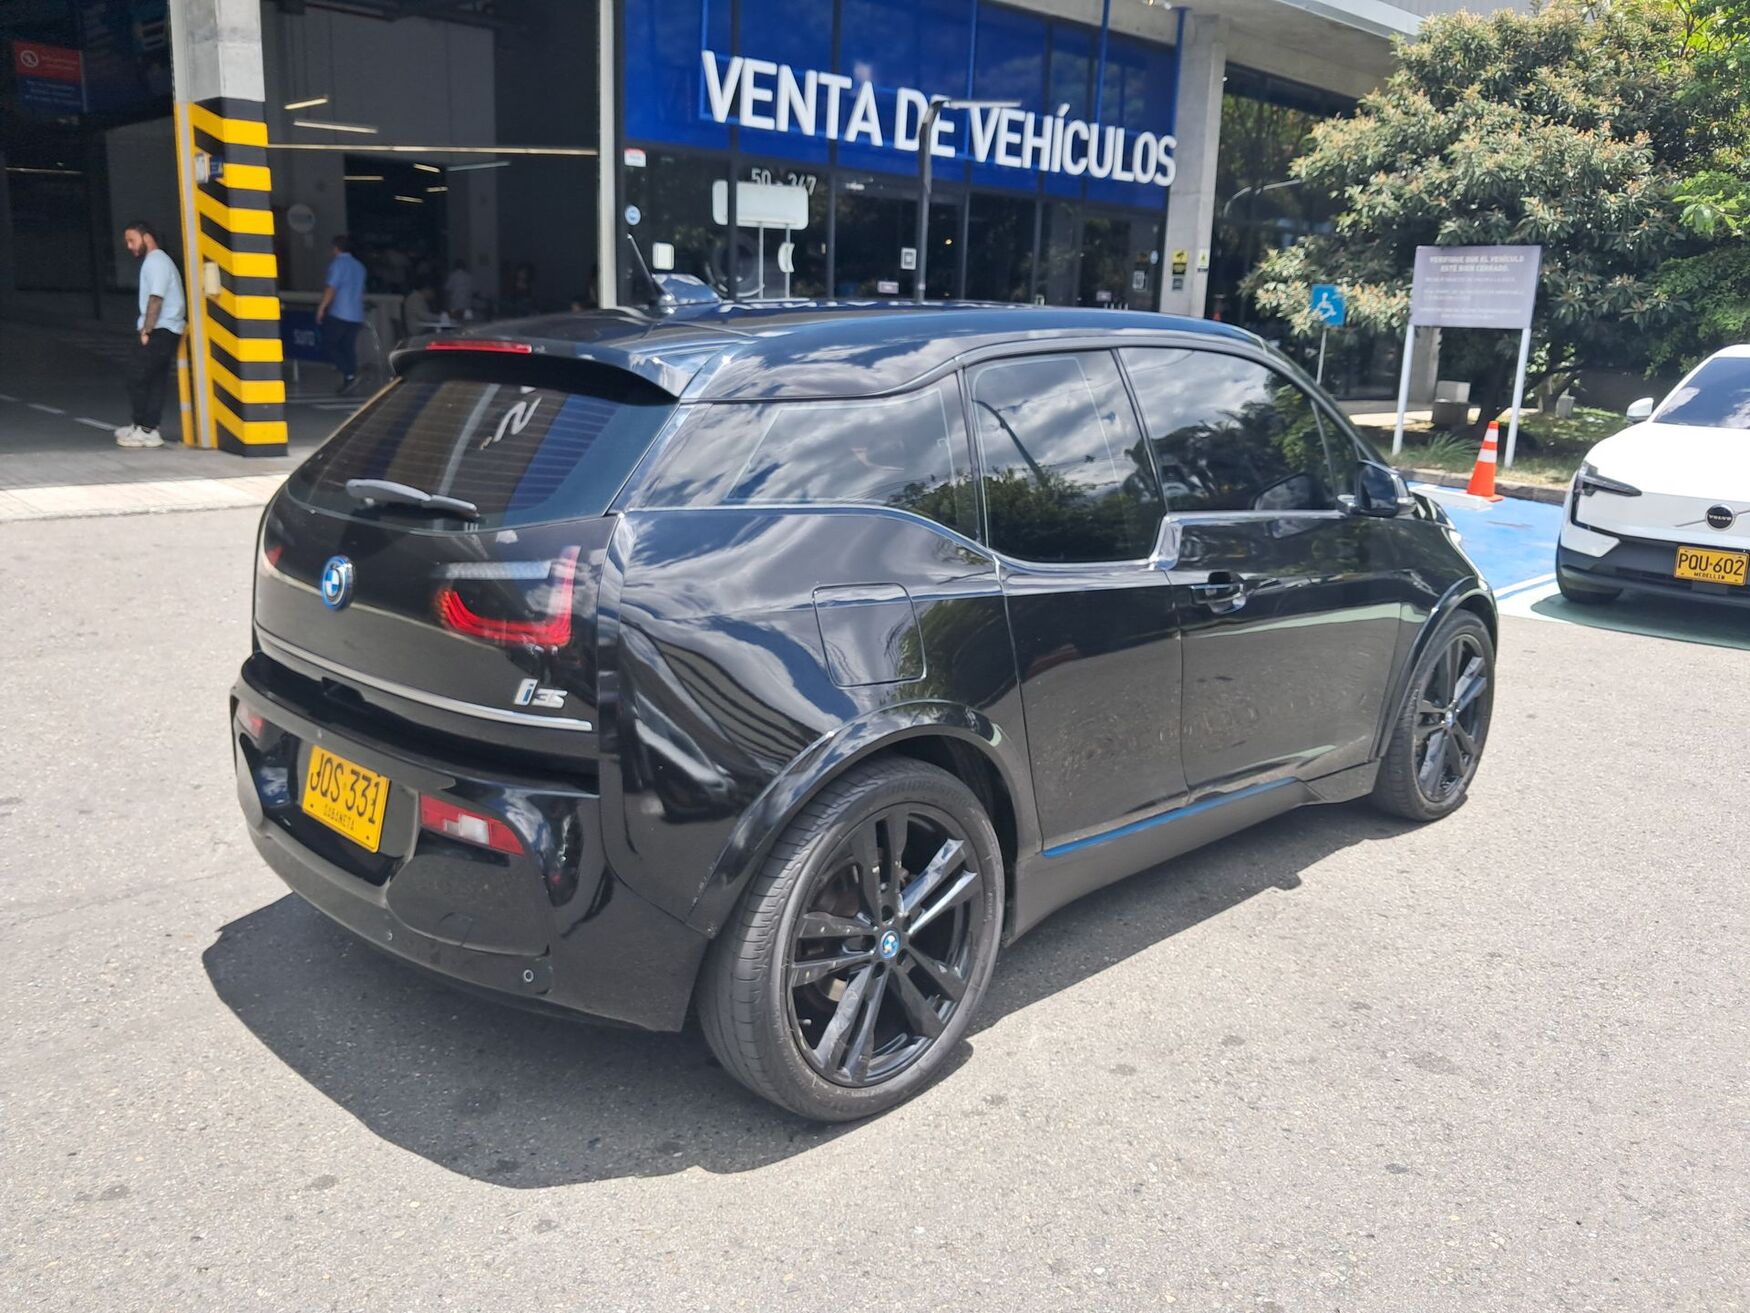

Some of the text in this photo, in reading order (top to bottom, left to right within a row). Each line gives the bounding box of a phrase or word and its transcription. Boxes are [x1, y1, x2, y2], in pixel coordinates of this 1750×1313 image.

[702, 50, 1177, 187] VENTA DE VEHÍCULOS
[310, 753, 380, 825] JQS 331
